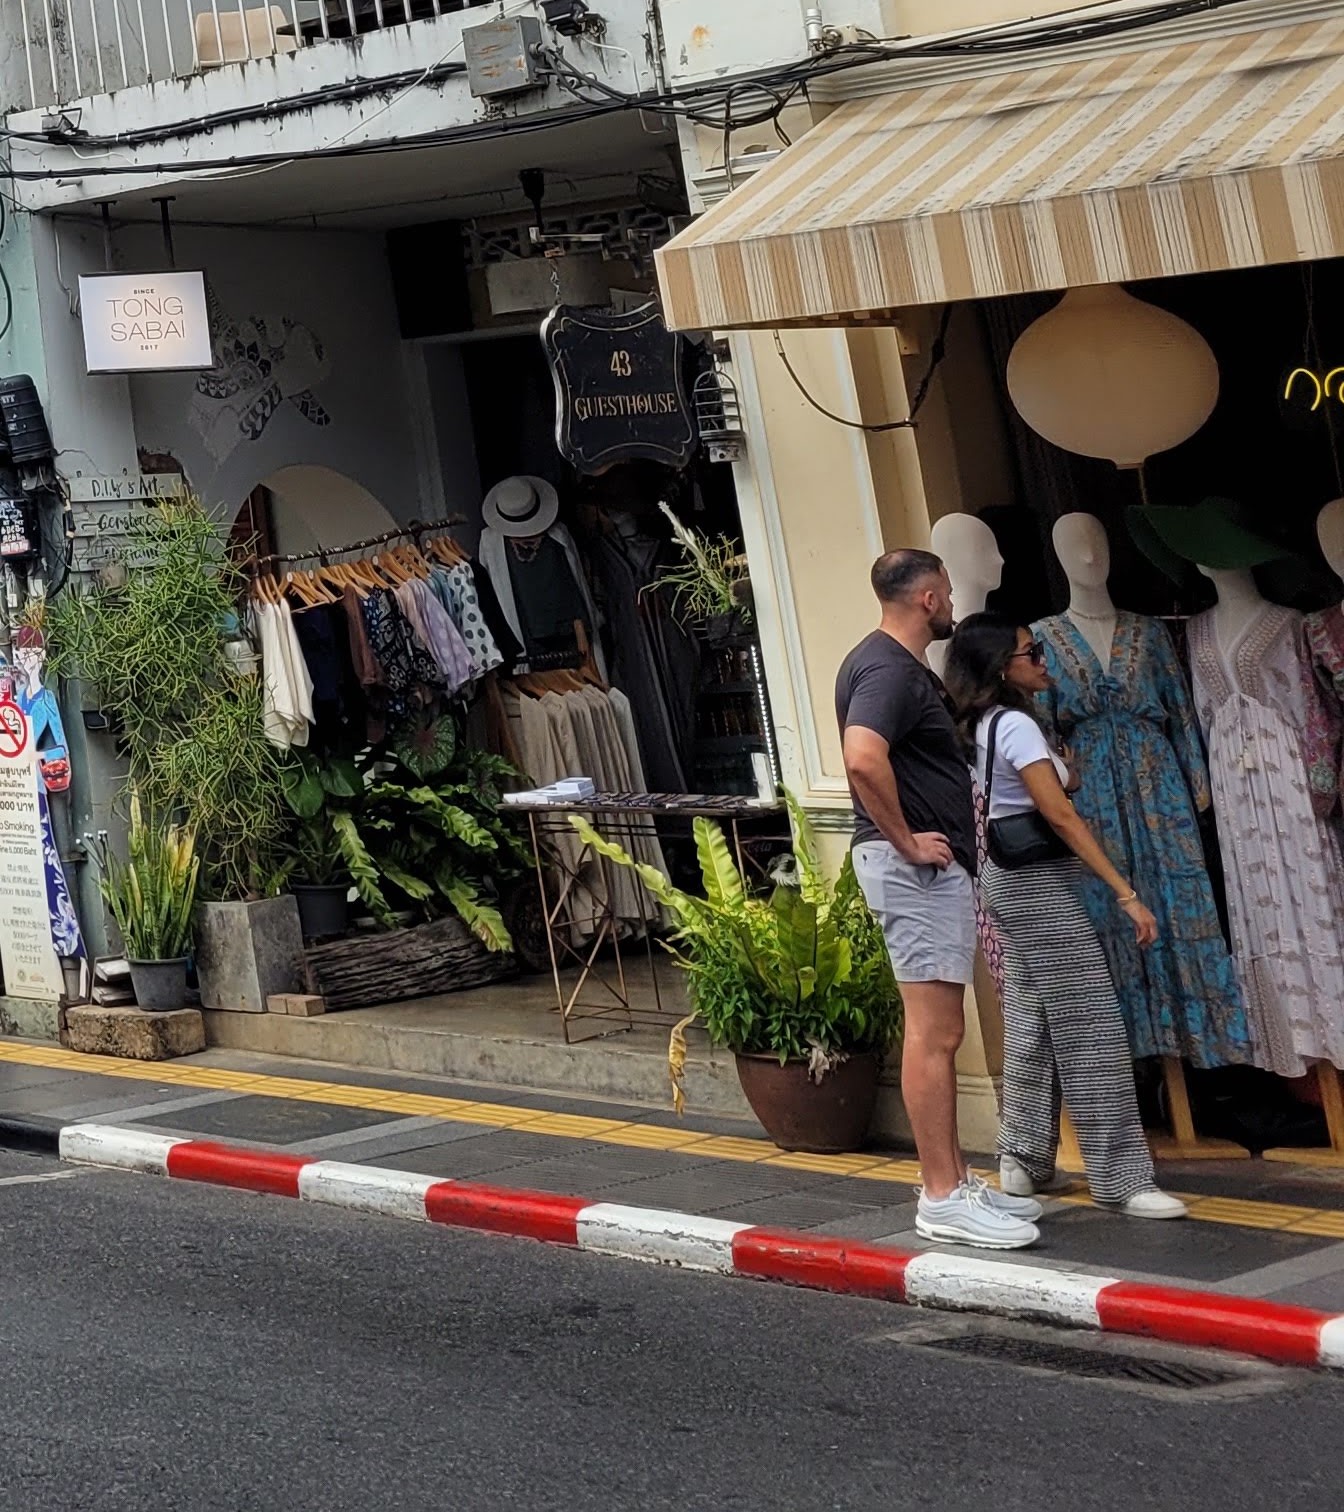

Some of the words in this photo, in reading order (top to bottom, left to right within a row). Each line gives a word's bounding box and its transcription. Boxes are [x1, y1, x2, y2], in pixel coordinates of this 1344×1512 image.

[105, 296, 184, 318] TONG
[110, 319, 185, 342] SABAI
[610, 350, 632, 377] 43
[574, 392, 678, 422] GUESTHOUSE
[16, 802, 35, 813] บาท
